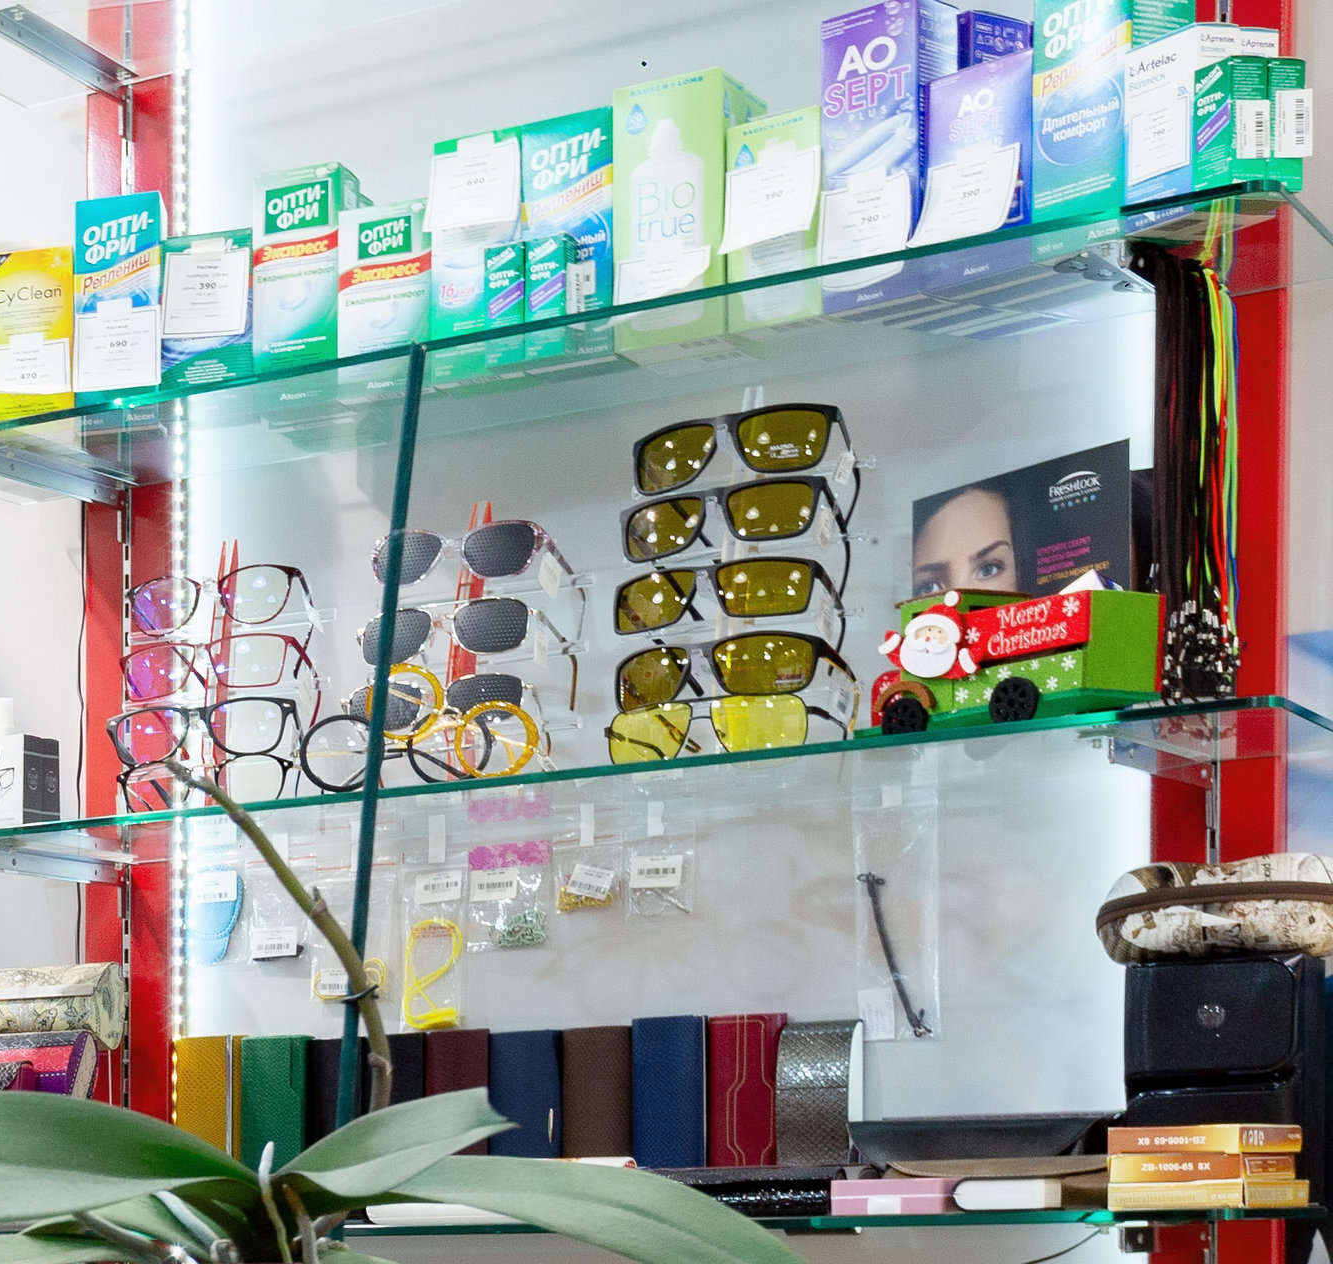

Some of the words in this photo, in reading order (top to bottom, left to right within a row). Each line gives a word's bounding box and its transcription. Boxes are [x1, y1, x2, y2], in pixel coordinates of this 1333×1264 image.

[836, 36, 897, 82] AO
[1137, 53, 1177, 75] Artelac
[824, 64, 911, 119] SEPT
[957, 89, 995, 119] AO
[848, 107, 887, 123] PLUS
[948, 106, 1003, 143] SEPT
[1042, 96, 1119, 134] Длительный
[1053, 117, 1108, 142] комфорт
[531, 128, 607, 172] ОПТИ-
[532, 154, 589, 190] ФРИ
[267, 184, 326, 215] ОПТИ-
[83, 211, 154, 246] ОПТИ-
[276, 202, 319, 230] ФРИ
[638, 213, 695, 242] true
[360, 218, 409, 244] ОПТИ-
[368, 232, 403, 256] ФРИ
[1087, 227, 1120, 240] Alcon
[85, 237, 136, 264] ФРИ
[262, 240, 328, 262] Экспресс
[83, 252, 151, 296] Реплениш
[198, 282, 216, 290] 390
[352, 262, 420, 284] Экспресс
[279, 390, 307, 402] Alcon
[367, 379, 394, 390] Alcon
[996, 600, 1052, 629] Merry
[987, 621, 1067, 656] Christmas
[1141, 1162, 1193, 1171] ZB-1006-6S
[1198, 1162, 1211, 1171] 8X
